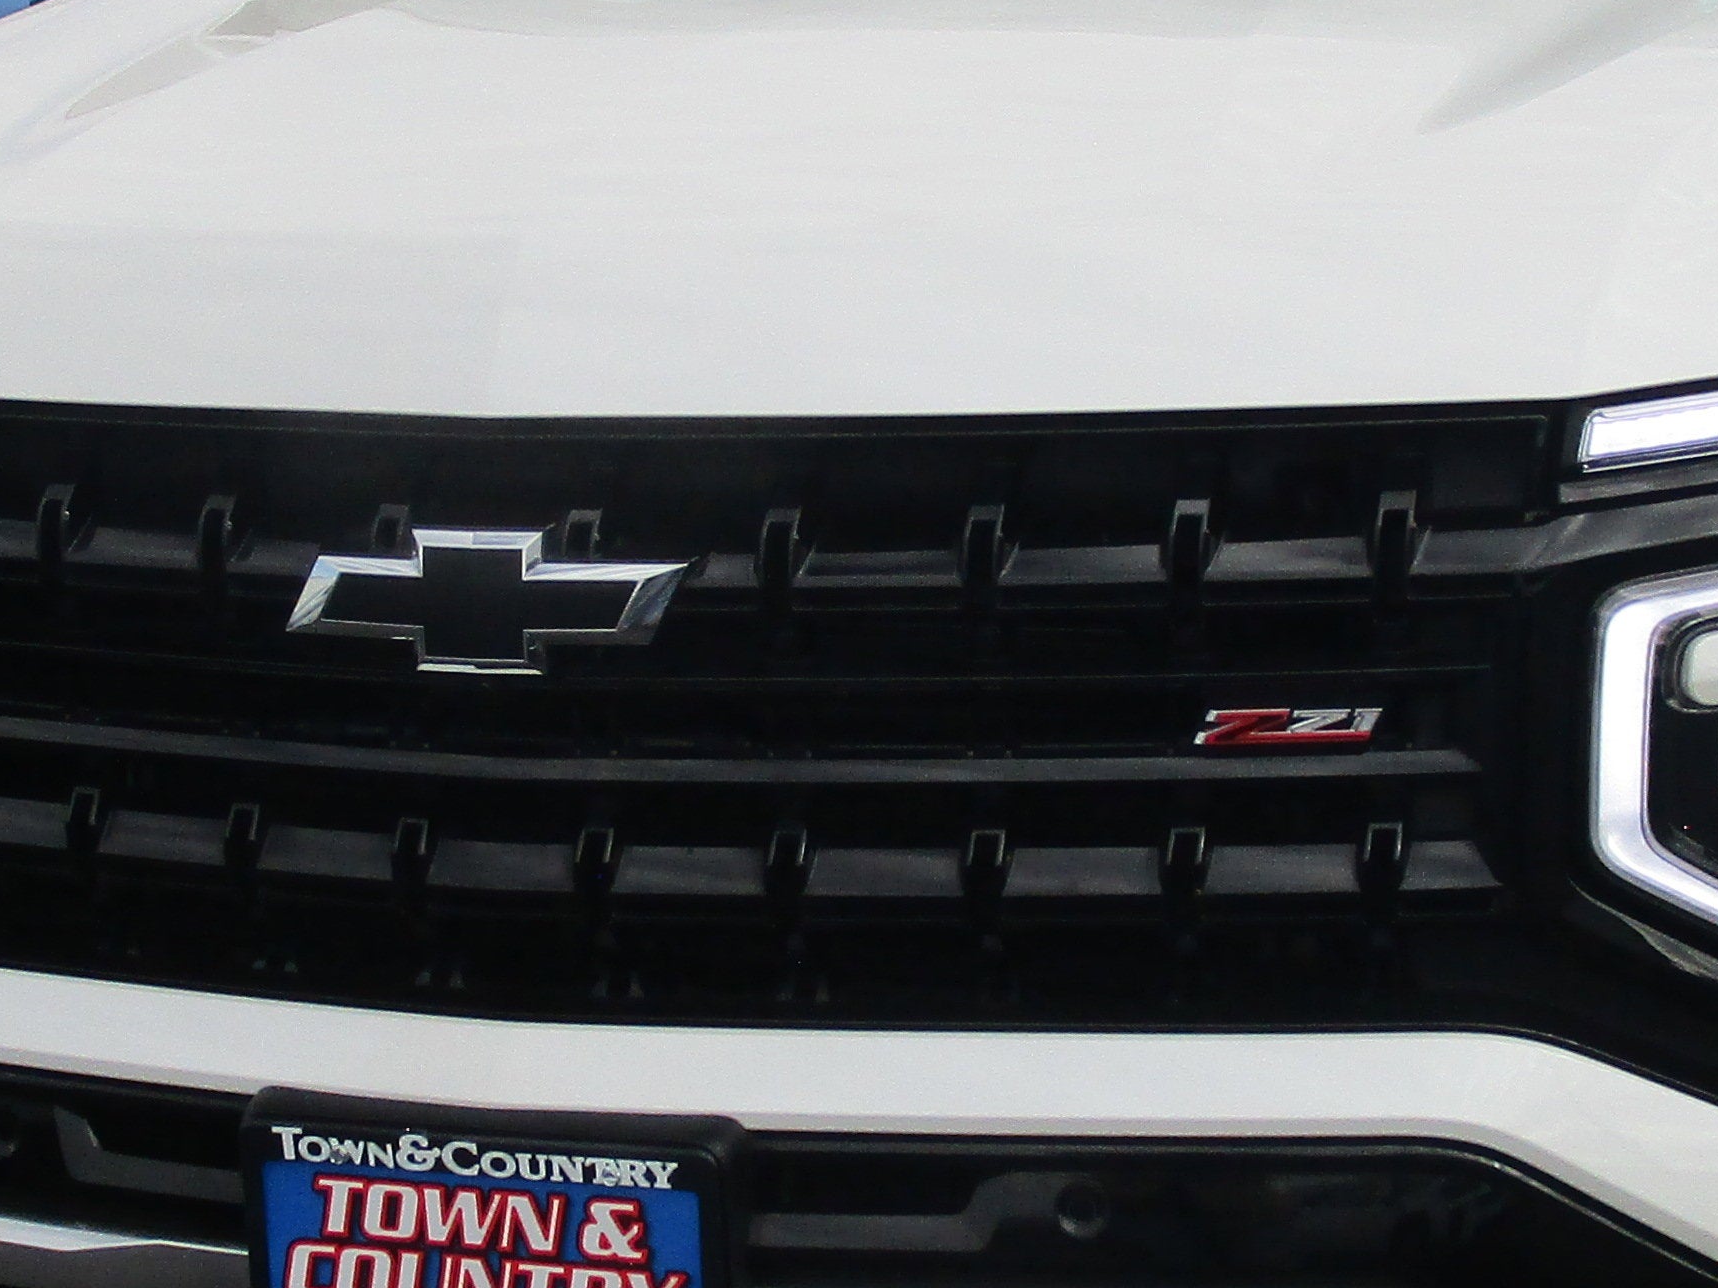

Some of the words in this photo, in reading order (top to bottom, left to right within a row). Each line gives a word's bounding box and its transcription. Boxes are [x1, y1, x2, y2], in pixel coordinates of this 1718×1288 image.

[1194, 709, 1382, 744] Z71
[315, 1175, 566, 1257] TOWN
[581, 1197, 648, 1264] &
